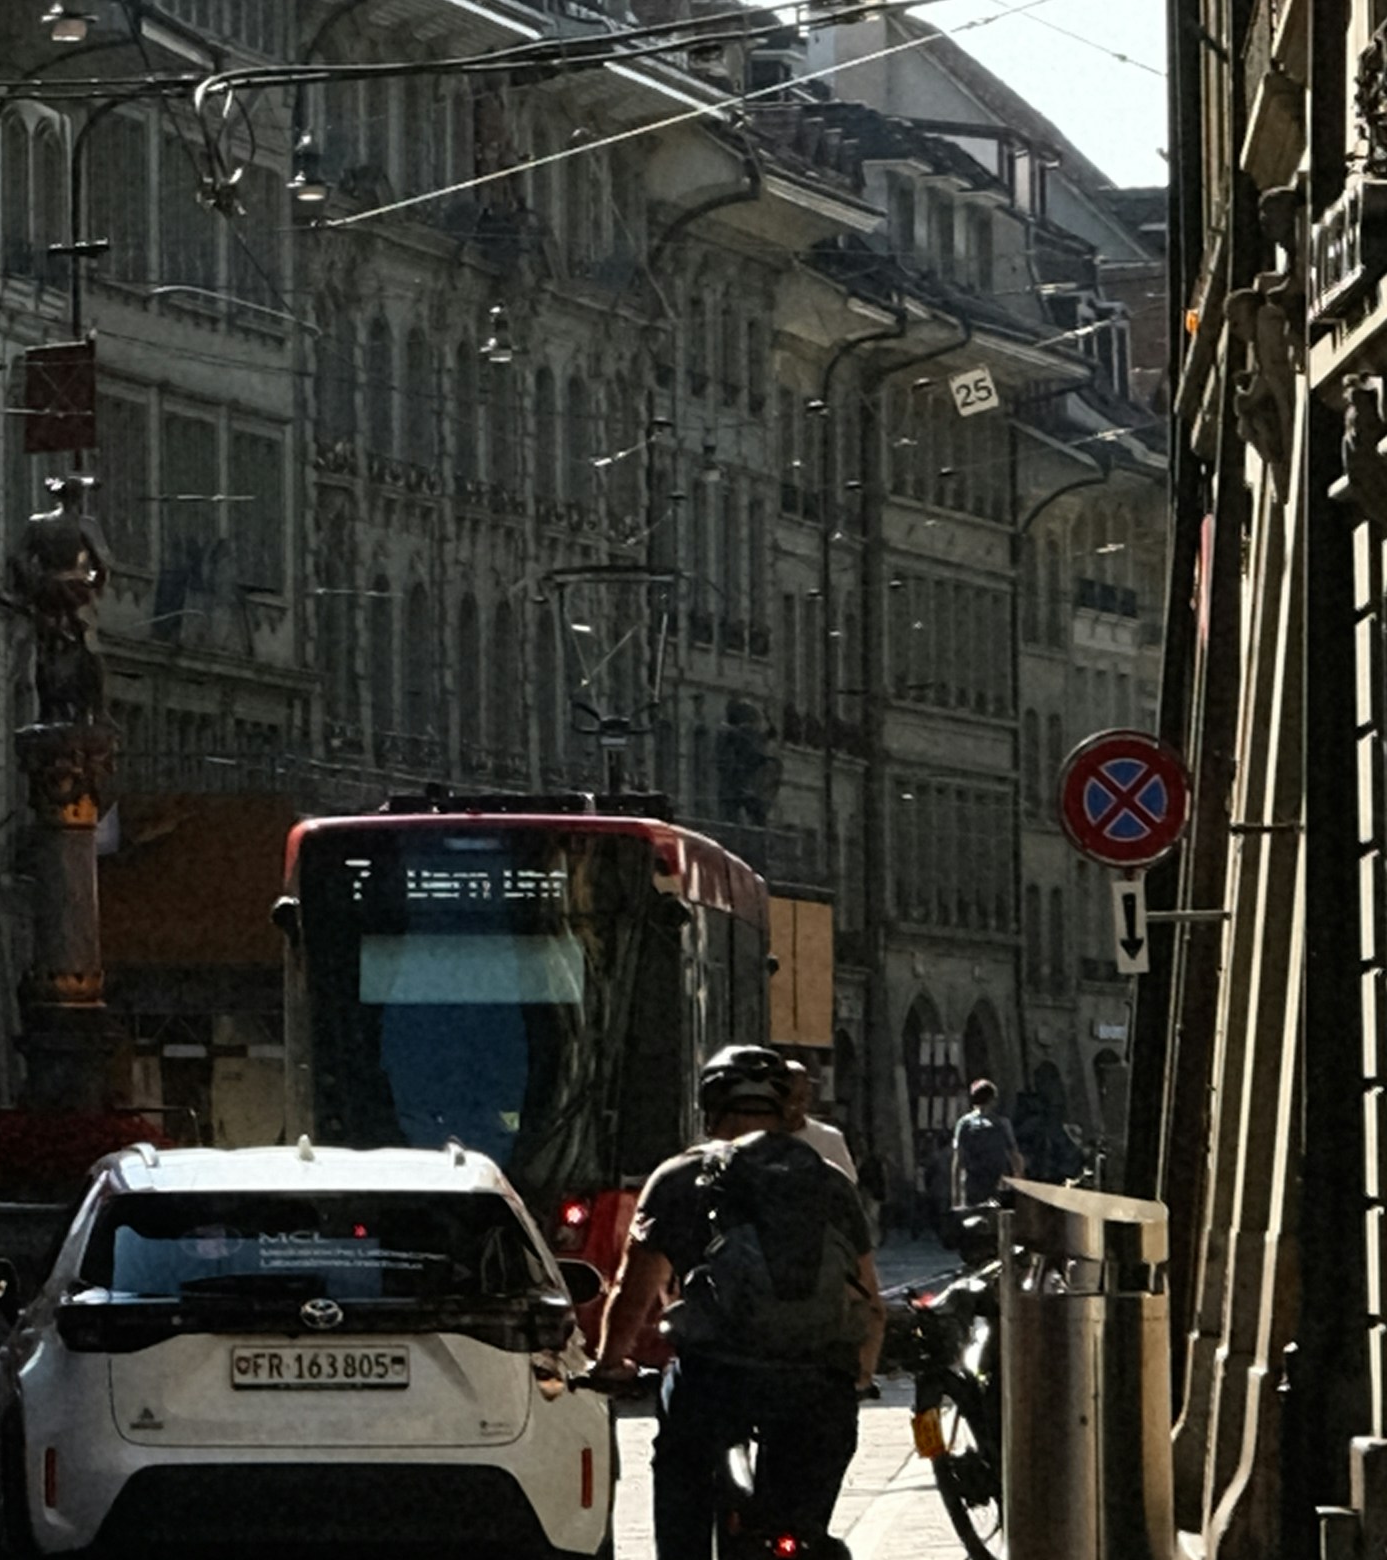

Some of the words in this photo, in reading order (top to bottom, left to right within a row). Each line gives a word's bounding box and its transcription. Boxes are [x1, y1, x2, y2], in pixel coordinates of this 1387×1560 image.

[955, 376, 993, 409] 25
[258, 1230, 331, 1244] MCL
[252, 1353, 284, 1379] FR
